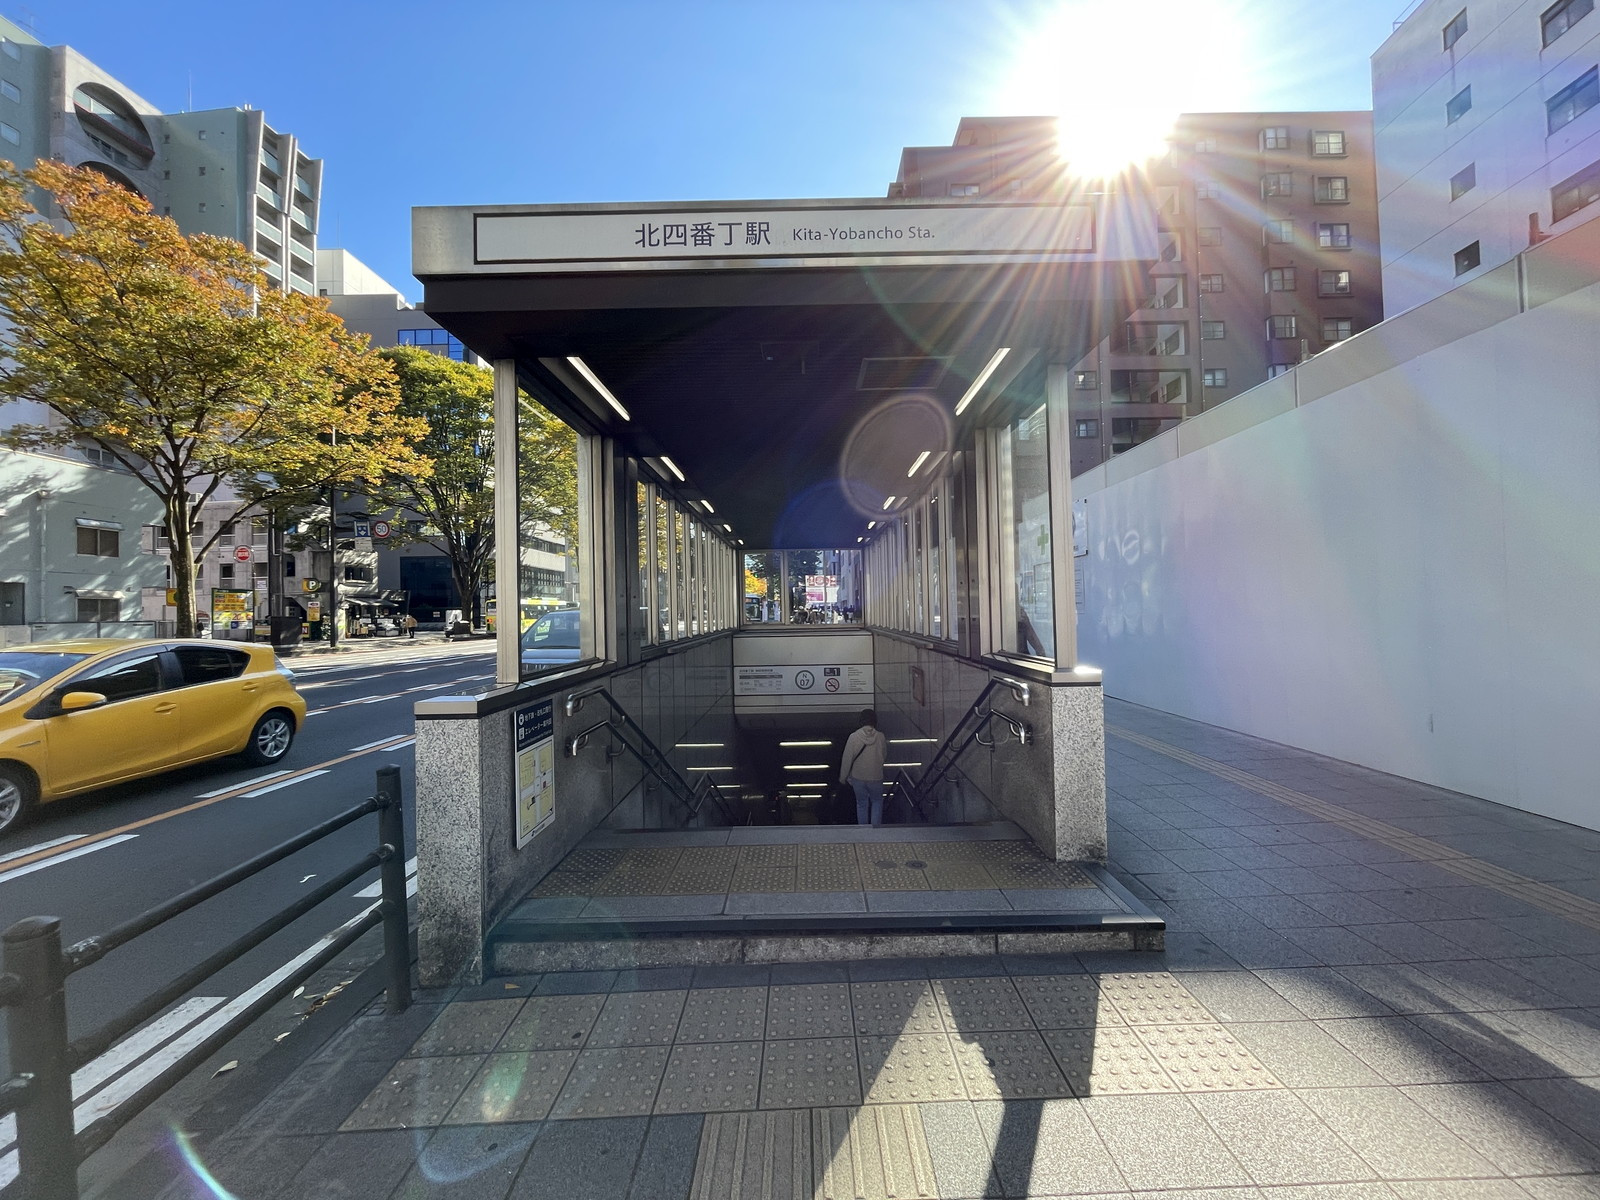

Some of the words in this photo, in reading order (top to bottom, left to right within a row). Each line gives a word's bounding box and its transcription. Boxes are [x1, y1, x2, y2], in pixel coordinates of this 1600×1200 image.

[634, 221, 771, 248] 北四番丁駅
[793, 226, 903, 241] Kita-Yobancho
[908, 226, 936, 240] Sta.
[376, 525, 387, 533] 50
[309, 580, 316, 590] P
[799, 679, 810, 687] 07
